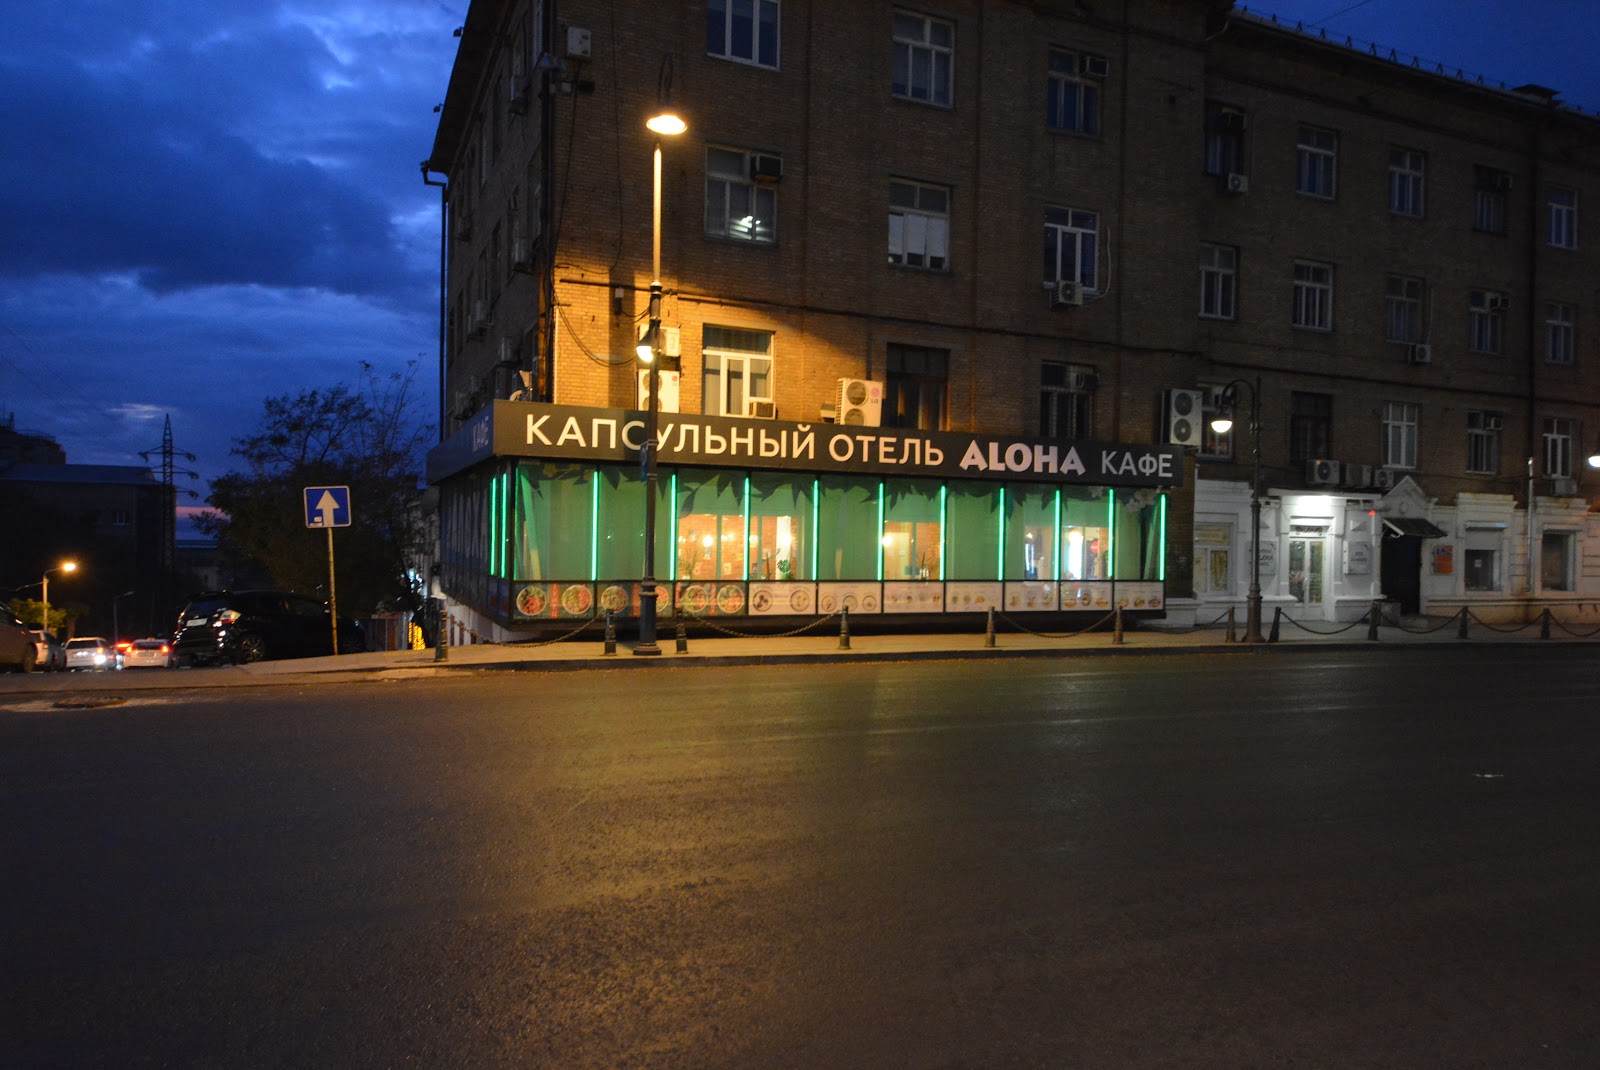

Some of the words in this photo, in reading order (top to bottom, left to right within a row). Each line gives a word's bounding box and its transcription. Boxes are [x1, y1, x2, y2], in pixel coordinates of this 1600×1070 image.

[525, 413, 816, 460] КАПСУЛЬНЫЙ
[828, 434, 944, 467] ОТЕЛЬ
[959, 439, 1086, 476] ALOHA
[1101, 450, 1173, 478] КАФЕ
